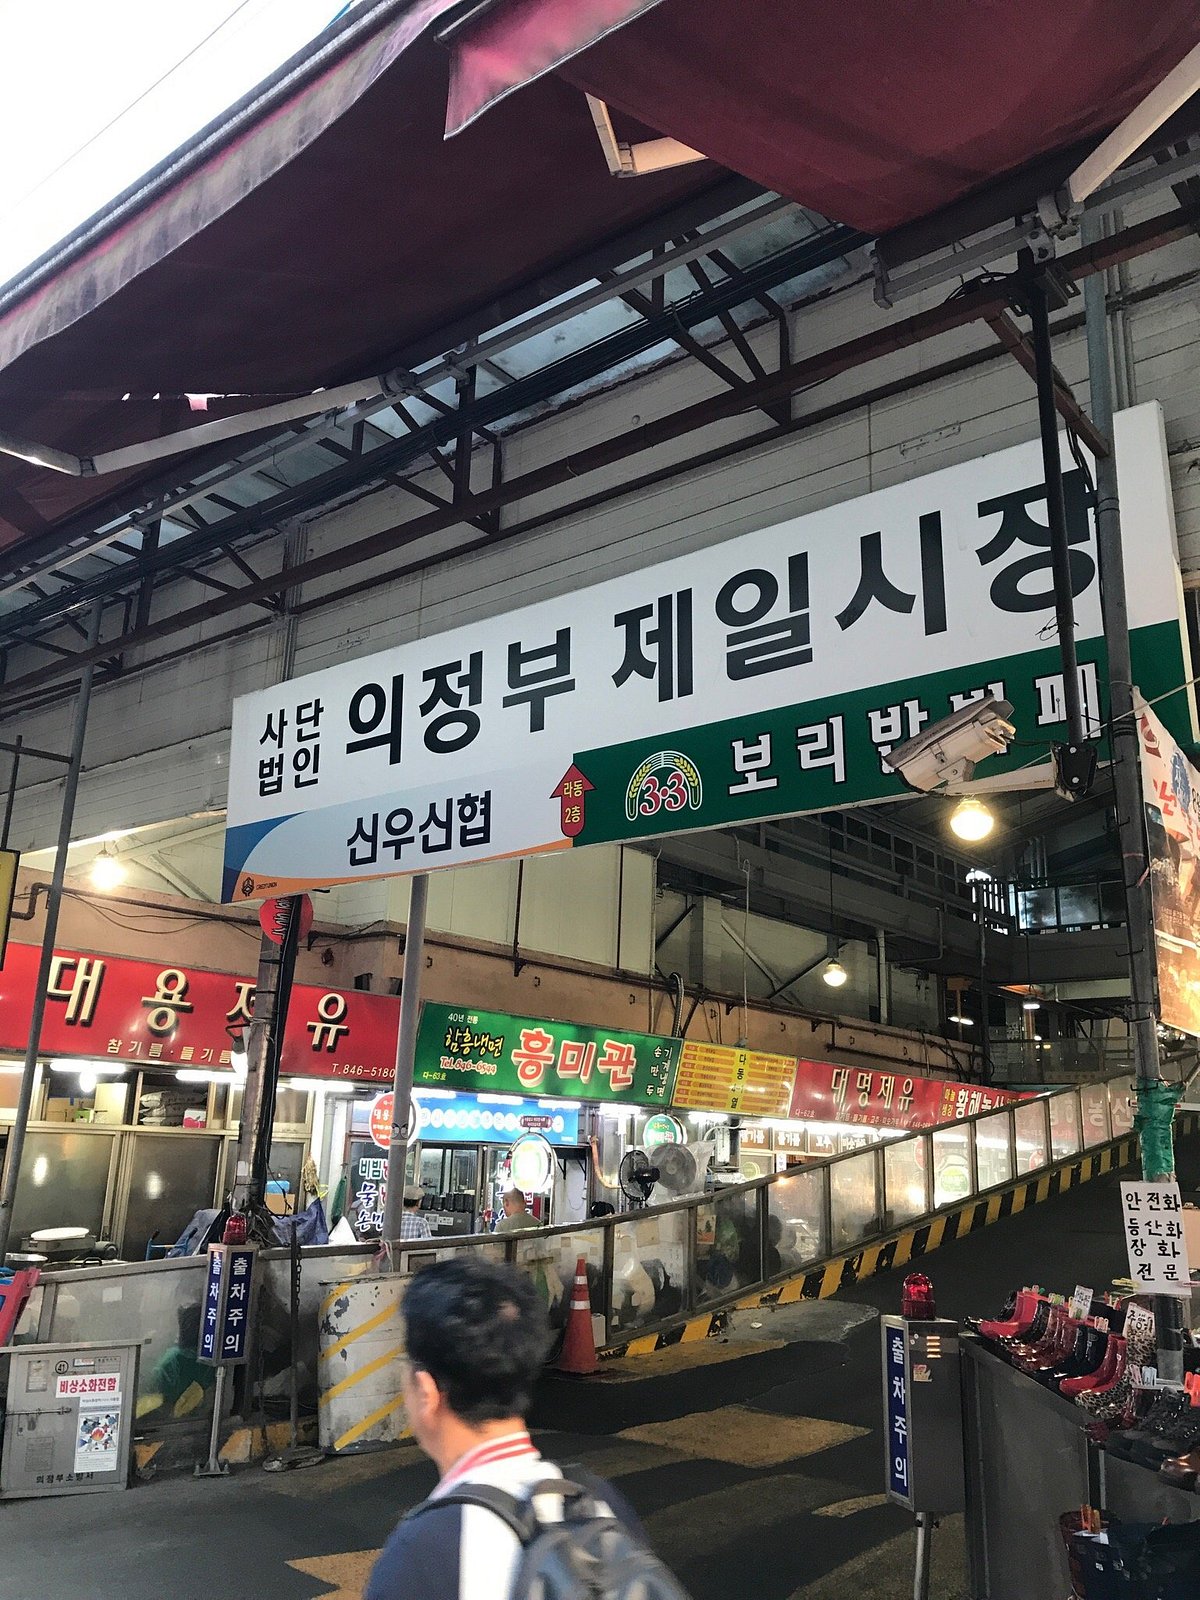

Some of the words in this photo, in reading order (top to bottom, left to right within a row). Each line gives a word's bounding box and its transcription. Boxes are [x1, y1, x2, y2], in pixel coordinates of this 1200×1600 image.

[346, 626, 577, 766] 의정부
[611, 468, 1098, 702] 제일시장
[260, 698, 324, 749] 사단
[258, 743, 320, 797] 법인
[563, 779, 584, 798] 라동
[347, 789, 492, 867] 신우신협
[564, 805, 581, 824] 2층
[447, 1012, 464, 1023] 40년
[444, 1025, 505, 1059] 함흥냉면
[511, 1027, 637, 1092] 흥미관
[831, 1067, 914, 1112] 대명제유
[1127, 1217, 1183, 1240] 등산화
[203, 1256, 222, 1353] 출차주의
[224, 1257, 249, 1353] 출차주의
[57, 1362, 66, 1373] 41
[59, 1376, 117, 1394] 비상소화전함
[891, 1336, 908, 1488] 출차주의
[35, 1471, 95, 1484] 의정부소방서
